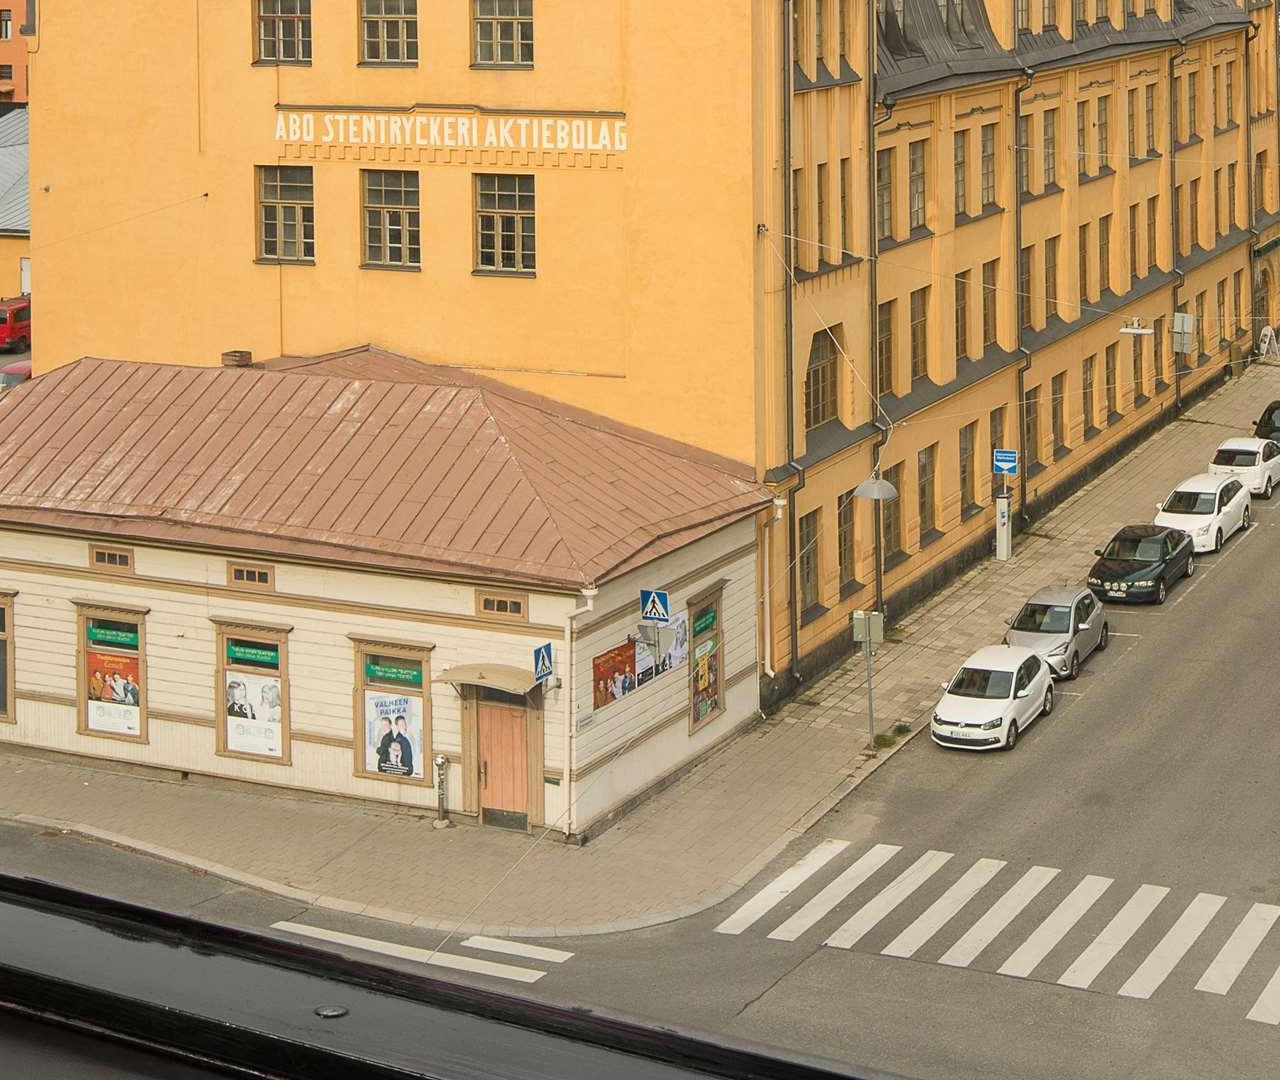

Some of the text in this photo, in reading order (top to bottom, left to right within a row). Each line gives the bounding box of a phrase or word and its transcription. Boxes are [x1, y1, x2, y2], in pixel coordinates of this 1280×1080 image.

[322, 114, 478, 147] STENTRYCKERI
[484, 118, 627, 151] AKTIEBOLAG
[374, 698, 409, 709] VALHEEN
[380, 708, 407, 716] PAIKKA
